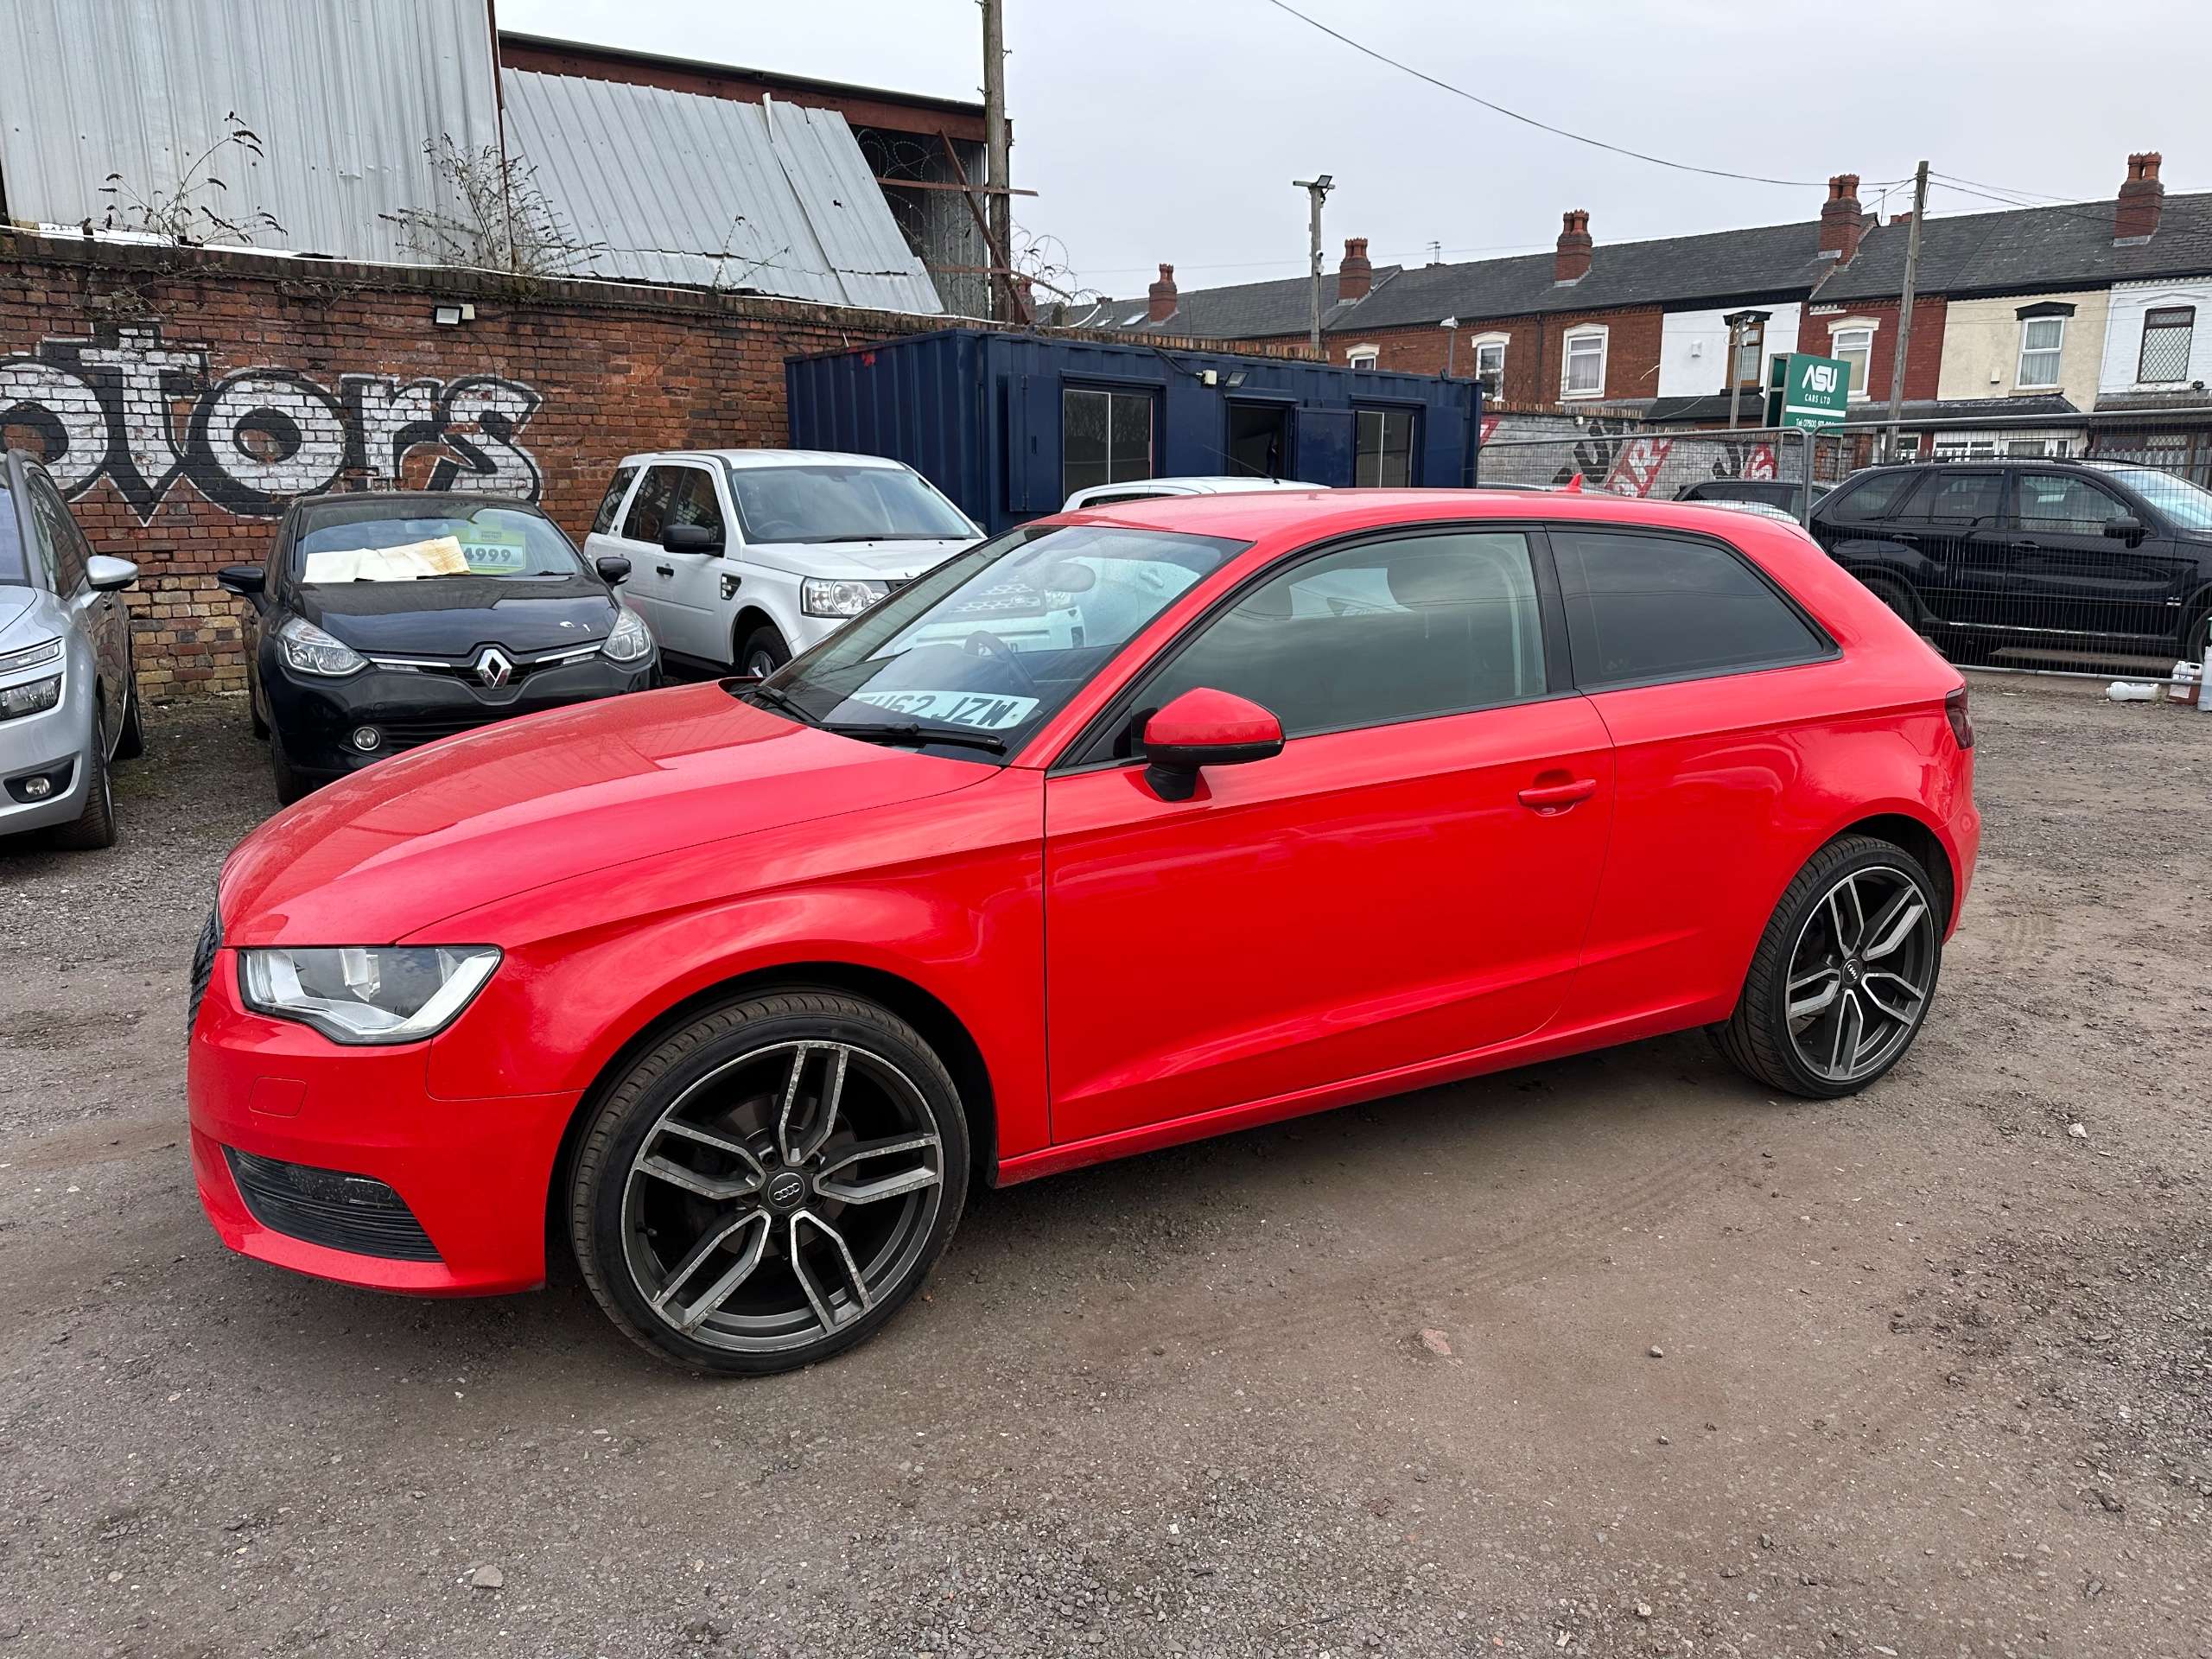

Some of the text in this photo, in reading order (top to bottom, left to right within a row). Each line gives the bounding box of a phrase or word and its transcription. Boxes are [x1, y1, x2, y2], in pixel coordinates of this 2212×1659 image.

[1802, 364, 1838, 393] ASU
[1820, 396, 1831, 405] LTD
[931, 696, 1018, 727] JZW
